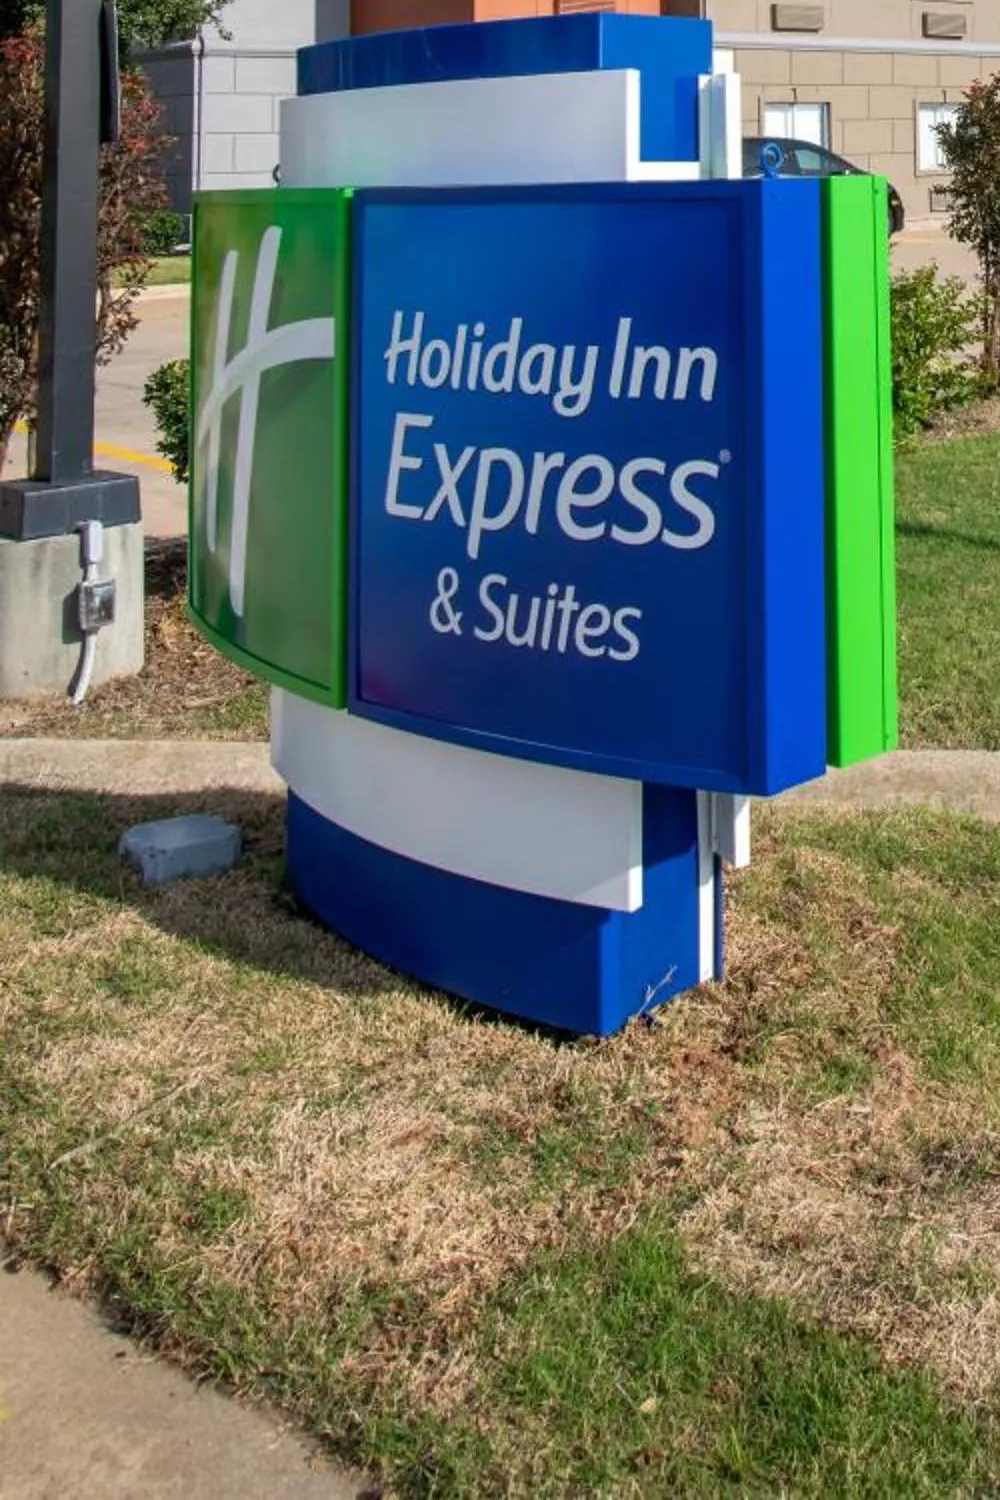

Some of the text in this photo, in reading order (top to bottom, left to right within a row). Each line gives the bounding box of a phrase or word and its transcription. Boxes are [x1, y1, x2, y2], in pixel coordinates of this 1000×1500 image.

[384, 310, 718, 417] Holiday Inn
[385, 411, 720, 560] Express
[429, 567, 642, 661] & Suites
